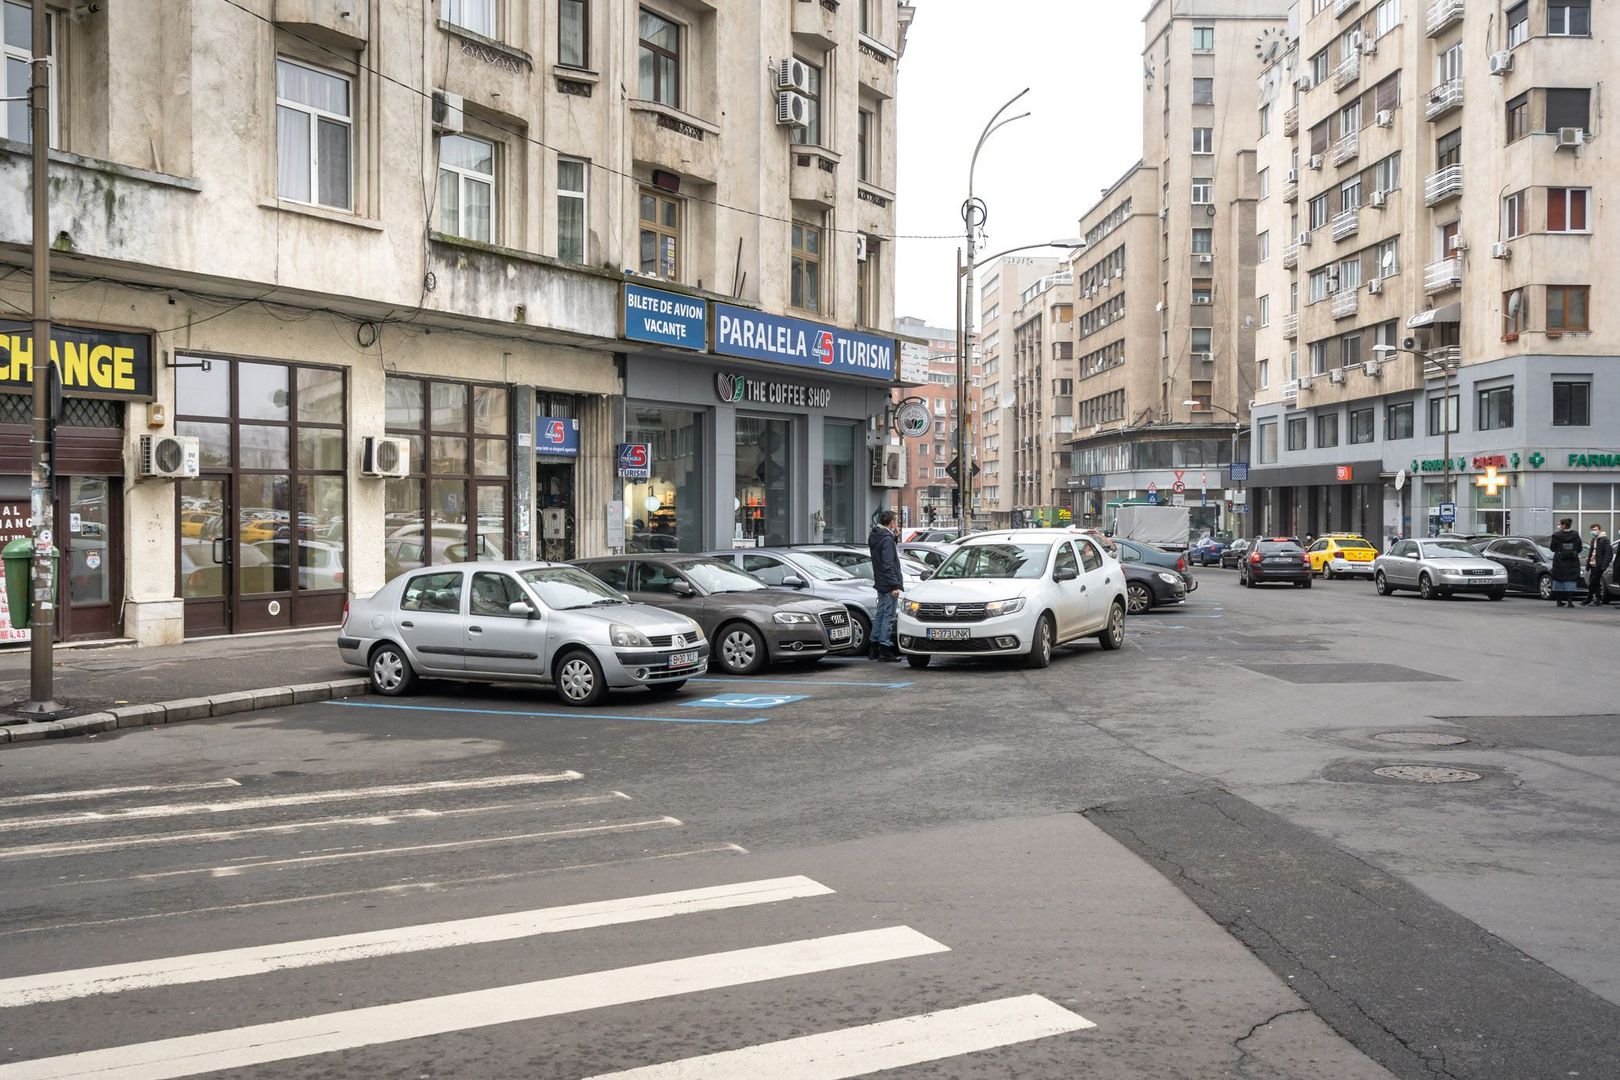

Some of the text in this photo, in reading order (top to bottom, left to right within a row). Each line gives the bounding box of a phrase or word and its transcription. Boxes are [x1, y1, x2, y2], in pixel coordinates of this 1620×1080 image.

[628, 293, 703, 320] BILETE DE AVION
[644, 318, 687, 340] VACANȚE
[720, 315, 807, 357] PARALELA
[838, 338, 891, 370] TURISM
[746, 380, 831, 407] THE COFFEE SHOP
[619, 469, 647, 477] TURISM
